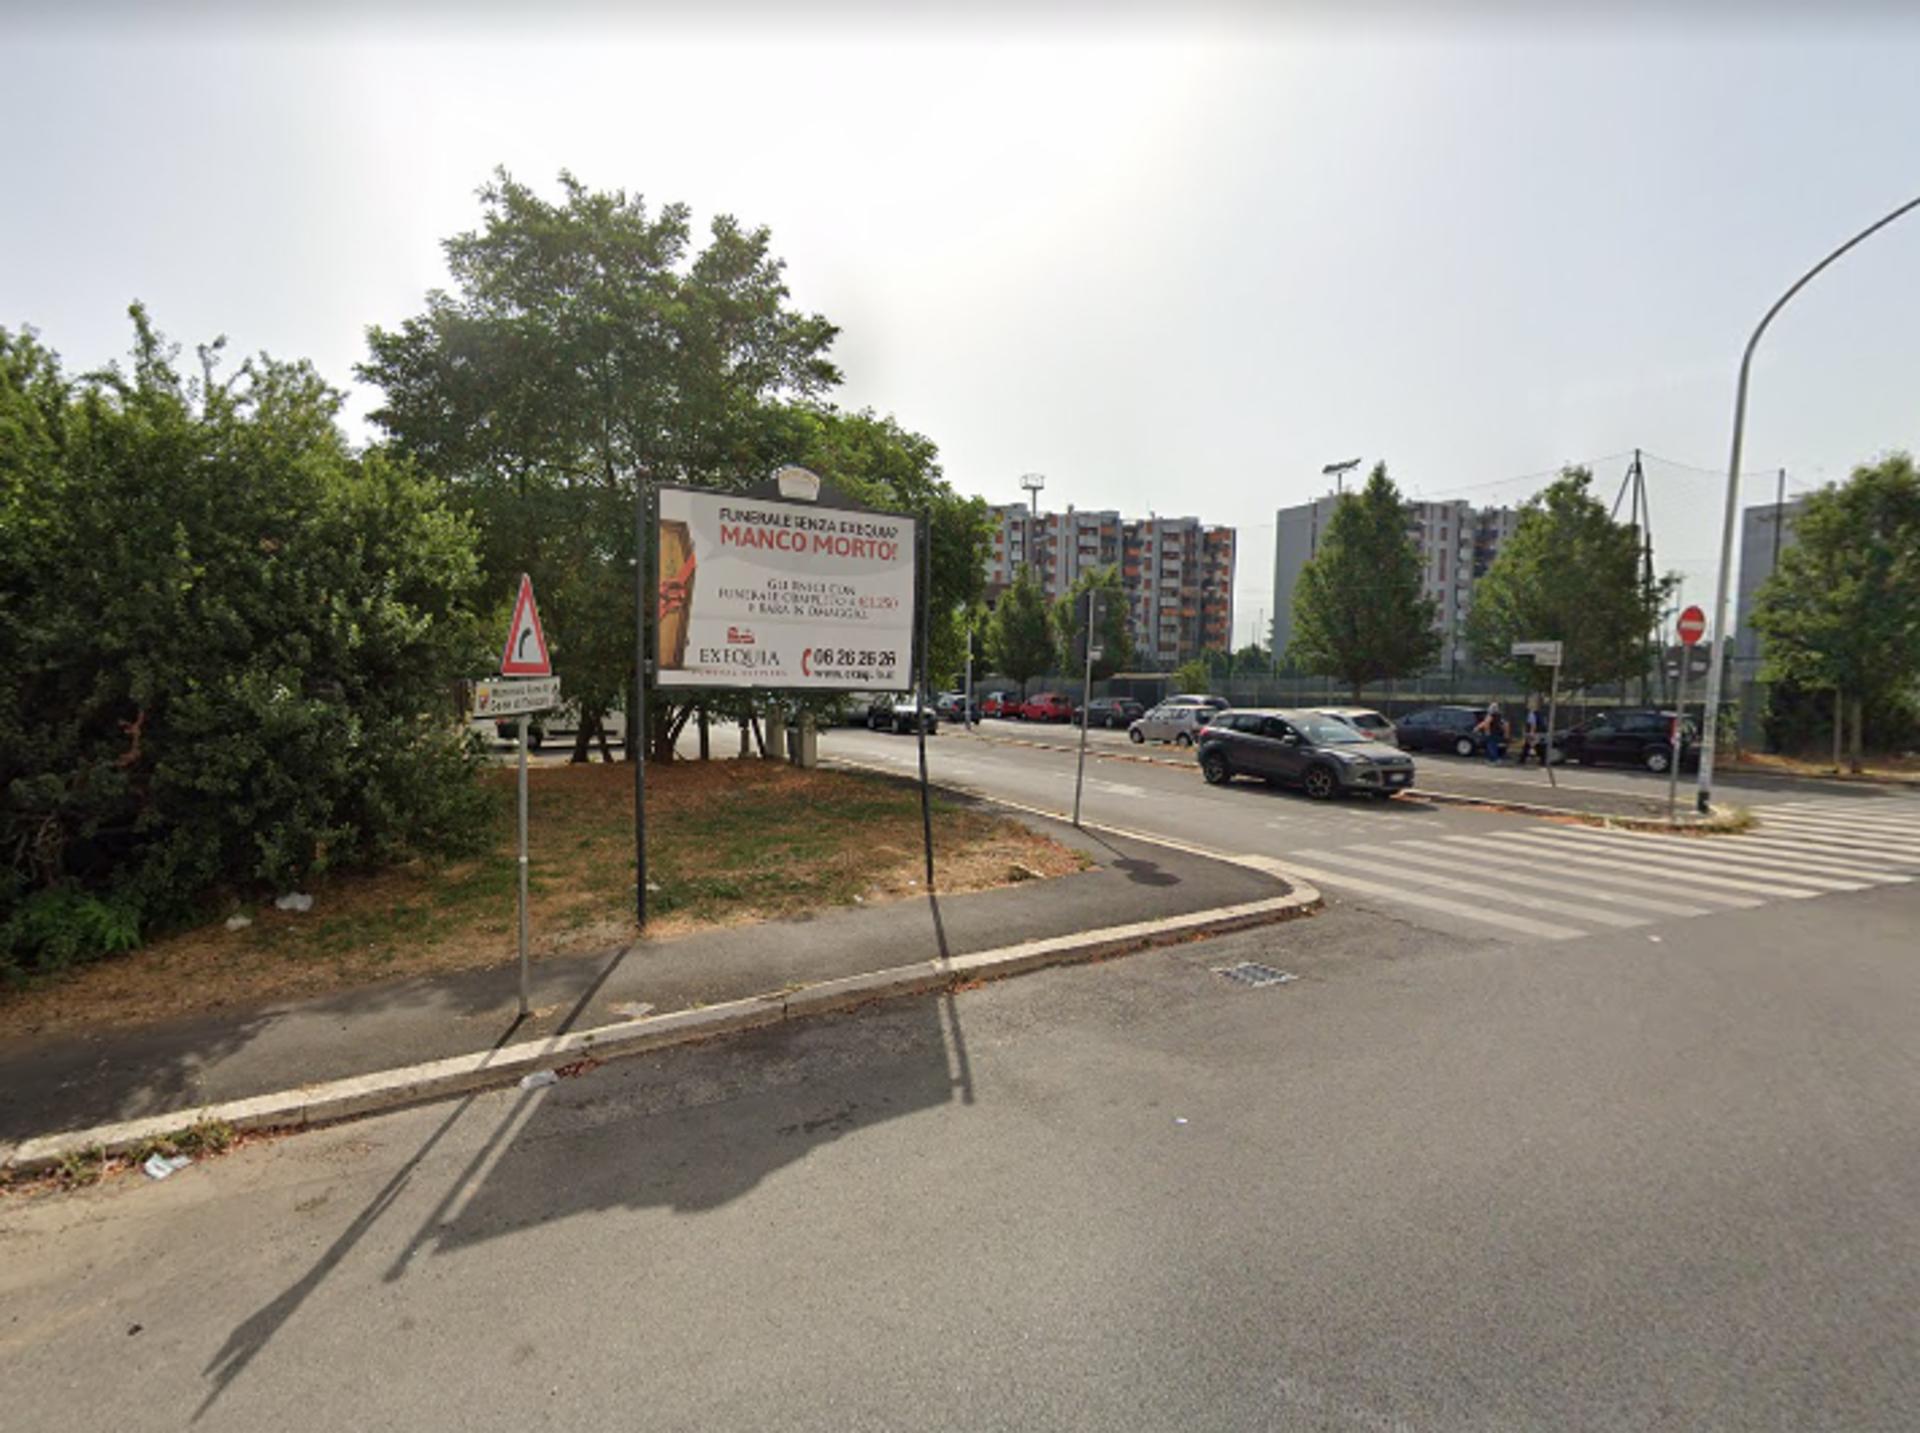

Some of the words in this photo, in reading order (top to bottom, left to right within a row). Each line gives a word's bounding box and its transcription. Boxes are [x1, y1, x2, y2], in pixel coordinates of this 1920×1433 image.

[718, 507, 791, 528] FUNERALE
[794, 515, 837, 532] SENZA
[720, 524, 808, 553] MANCO
[813, 533, 898, 561] MORTO!
[699, 648, 780, 668] EXEQUIA
[813, 648, 834, 666] 06
[836, 648, 856, 666] 26
